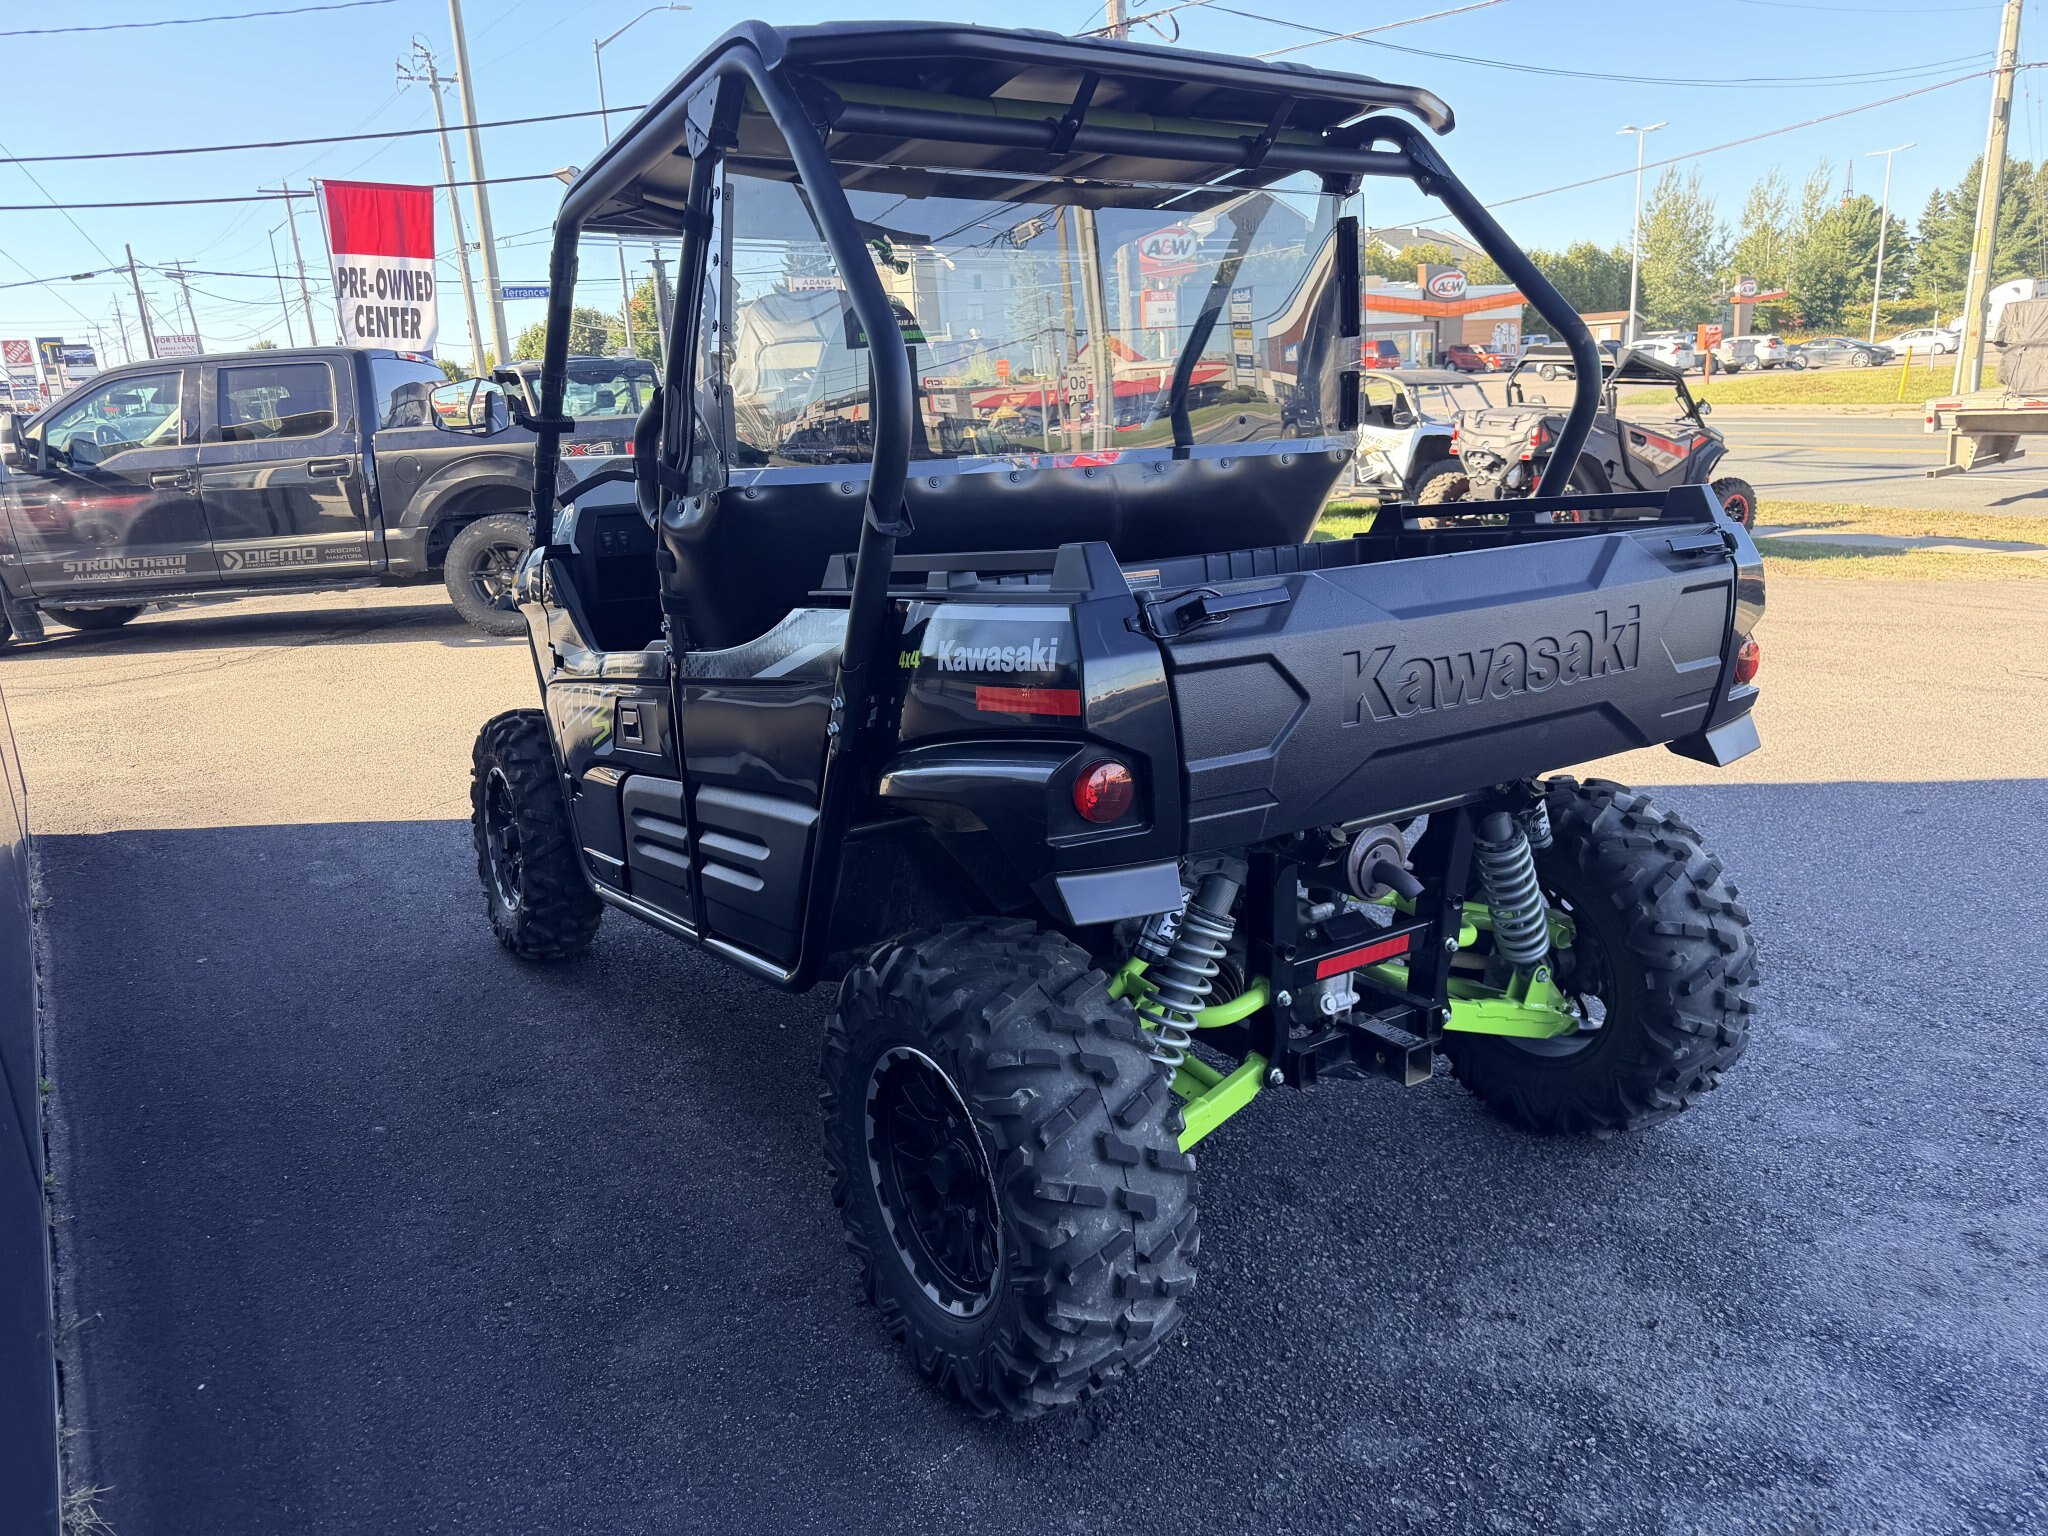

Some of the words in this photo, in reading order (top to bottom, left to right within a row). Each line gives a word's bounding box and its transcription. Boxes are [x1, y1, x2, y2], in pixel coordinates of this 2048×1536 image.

[1147, 239, 1191, 256] A&W
[337, 266, 433, 302] PRE-OWNED
[504, 288, 546, 297] Terrance
[1437, 281, 1464, 293] A&W
[354, 304, 421, 340] CENTER
[244, 547, 317, 563] DIEMO
[324, 546, 362, 555] ARBORG
[73, 569, 131, 581] ALUMINUM
[133, 567, 187, 577] TRAILERS
[899, 650, 921, 669] 4x4
[937, 637, 1059, 673] Kawasaki
[1342, 604, 1641, 728] Kawasaki
